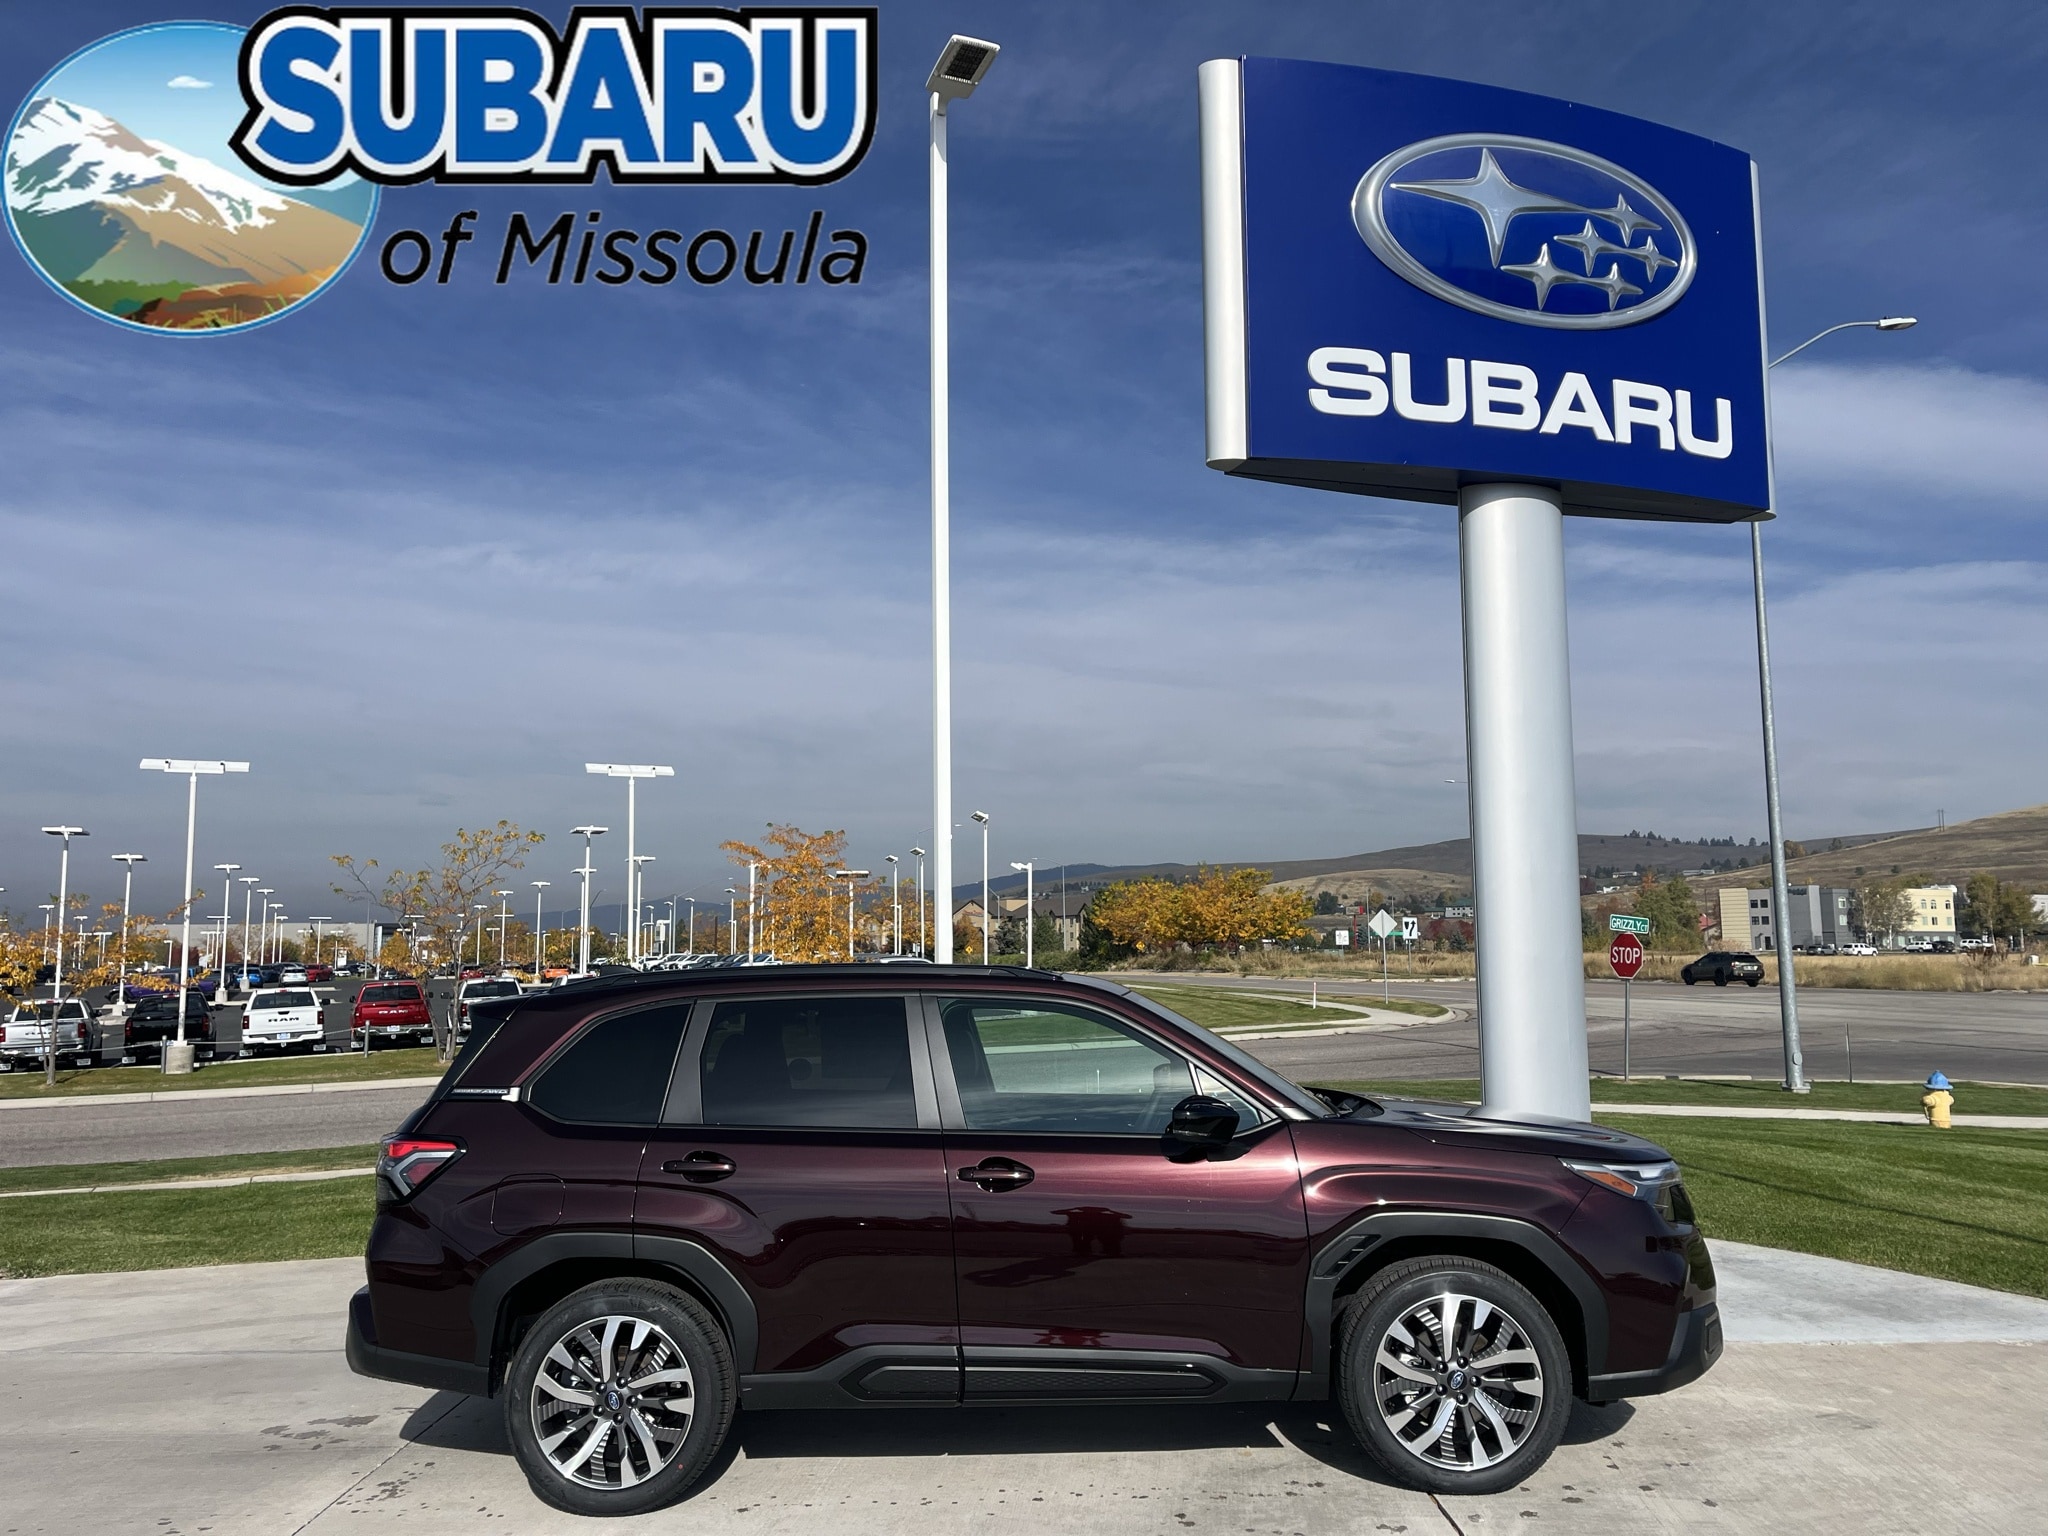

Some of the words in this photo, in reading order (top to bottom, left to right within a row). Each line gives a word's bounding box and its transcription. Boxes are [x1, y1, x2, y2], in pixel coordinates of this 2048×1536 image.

[1307, 346, 1733, 459] SUBARU
[1611, 918, 1642, 931] GRIZZLY
[1611, 946, 1641, 965] STOP
